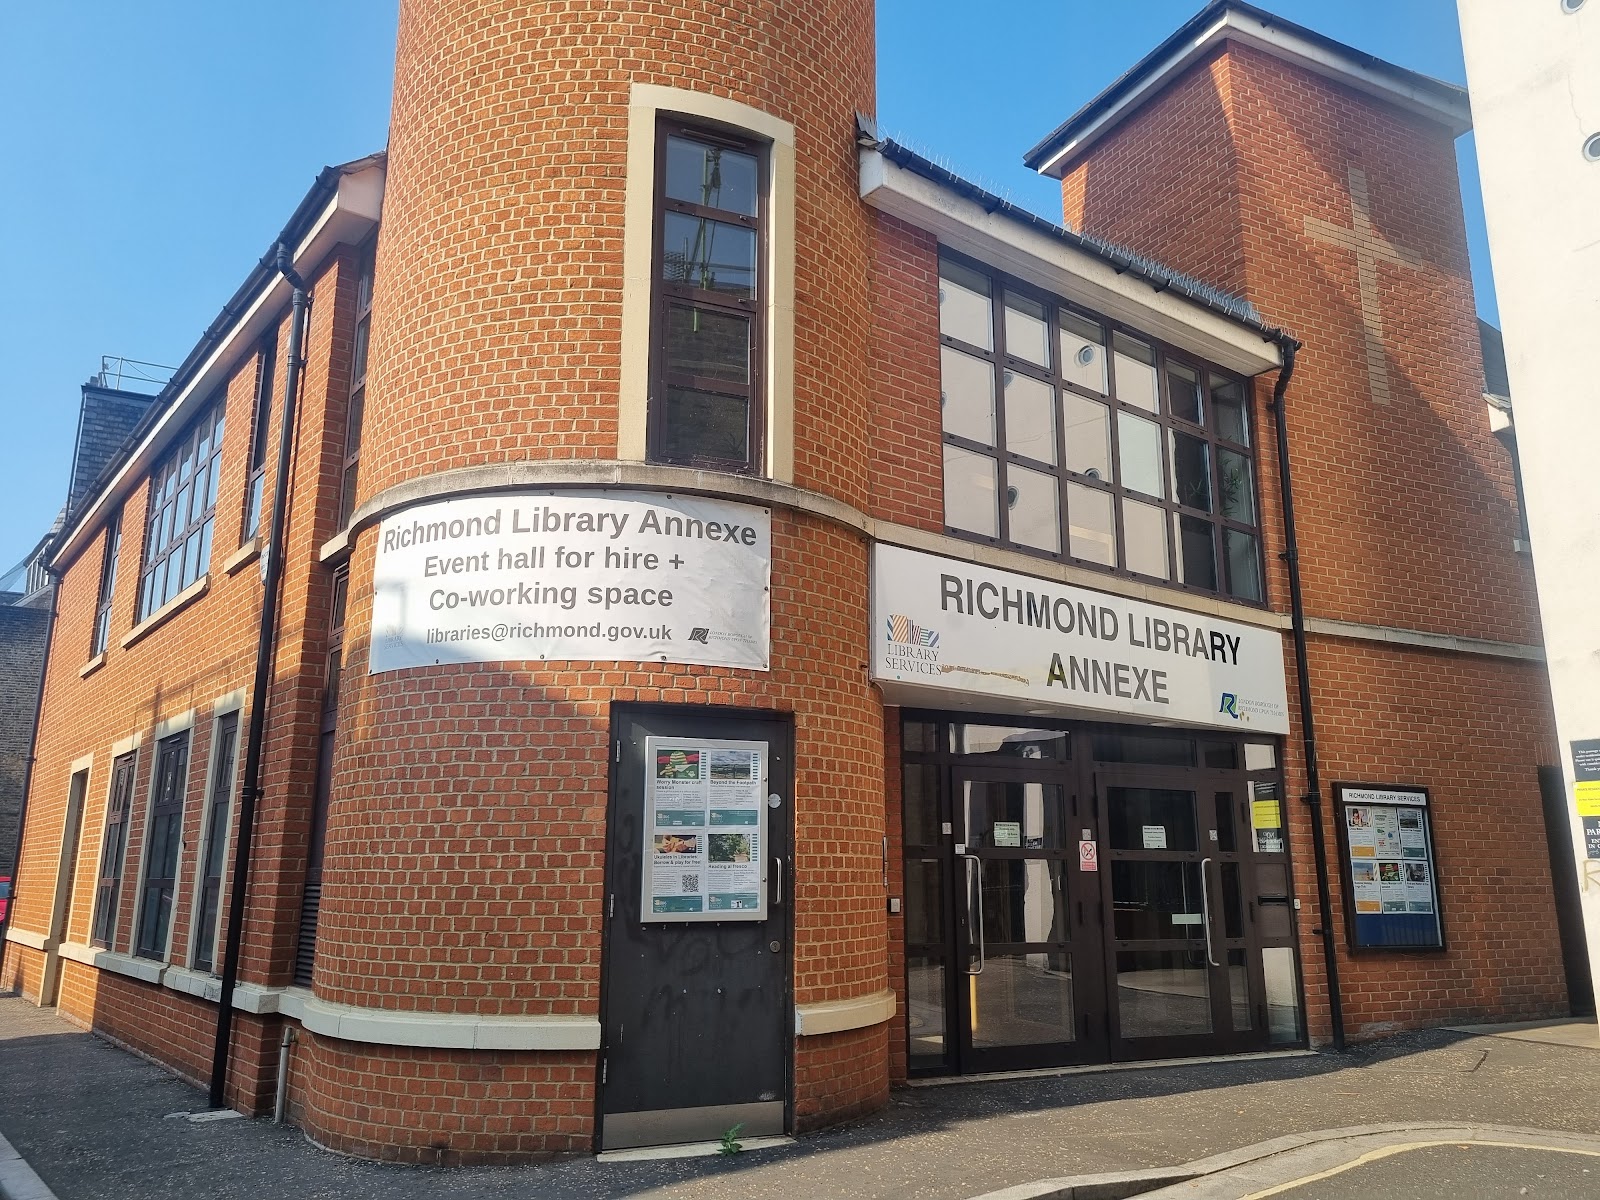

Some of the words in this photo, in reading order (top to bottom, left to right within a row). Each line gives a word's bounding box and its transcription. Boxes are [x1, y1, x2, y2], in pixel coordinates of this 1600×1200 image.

[383, 508, 502, 553] Richmond
[512, 506, 630, 539] Library
[638, 509, 757, 546] Annexe
[424, 551, 489, 577] Event
[497, 546, 545, 570] hall
[555, 545, 595, 569] for
[604, 546, 659, 570] hire
[668, 553, 685, 570] +
[429, 581, 577, 611] Co-working
[587, 585, 673, 610] space
[426, 621, 673, 643] libraries@richmond.gov.uk
[940, 573, 1119, 642] RICHMOND
[1128, 612, 1241, 666] LIBRARY
[885, 656, 943, 676] SERVICES
[887, 643, 940, 662] LIBRARY
[1046, 652, 1170, 705] ANNEXE
[1348, 792, 1376, 800] RICHMOND
